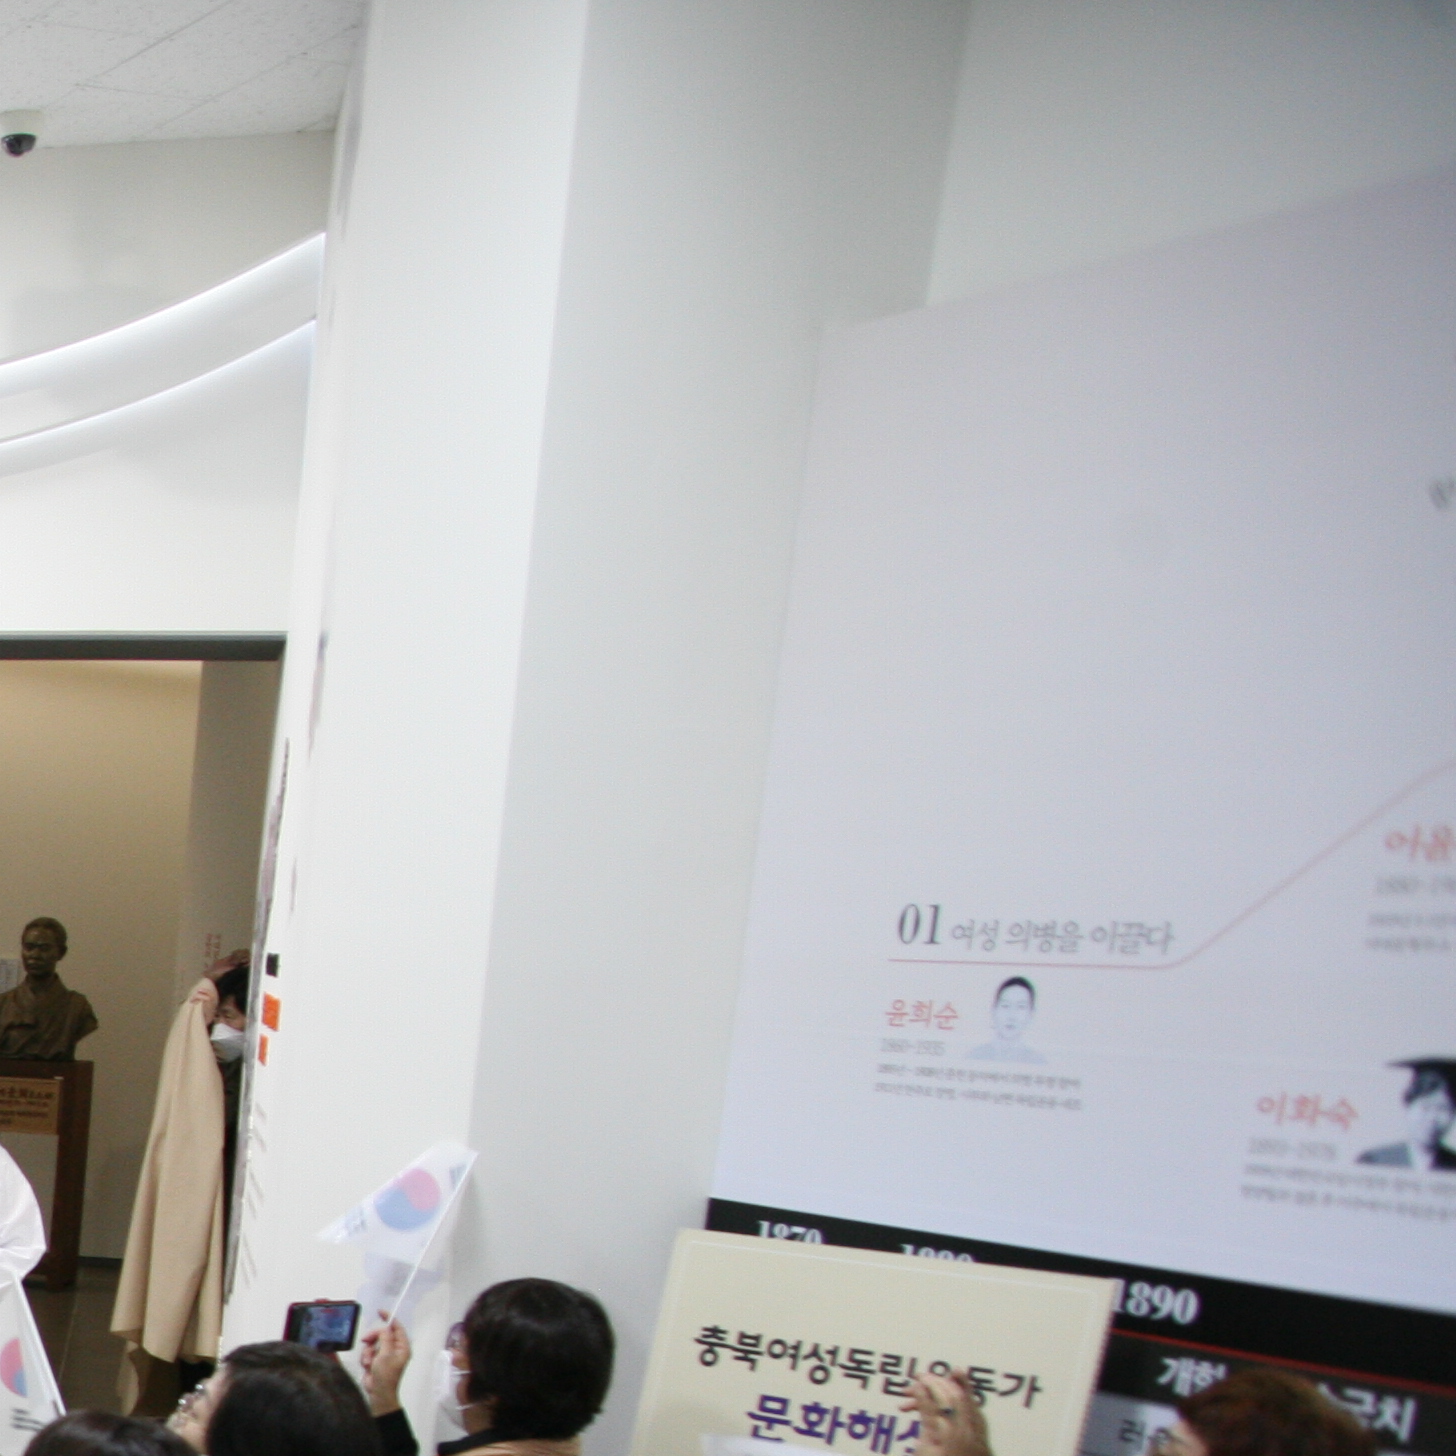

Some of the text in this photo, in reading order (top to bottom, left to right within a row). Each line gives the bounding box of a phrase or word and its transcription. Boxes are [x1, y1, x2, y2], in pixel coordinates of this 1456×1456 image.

[897, 903, 941, 945] 01
[951, 919, 1001, 952] 여성
[885, 999, 959, 1030] 윤희순
[1112, 1278, 1199, 1326] 1890
